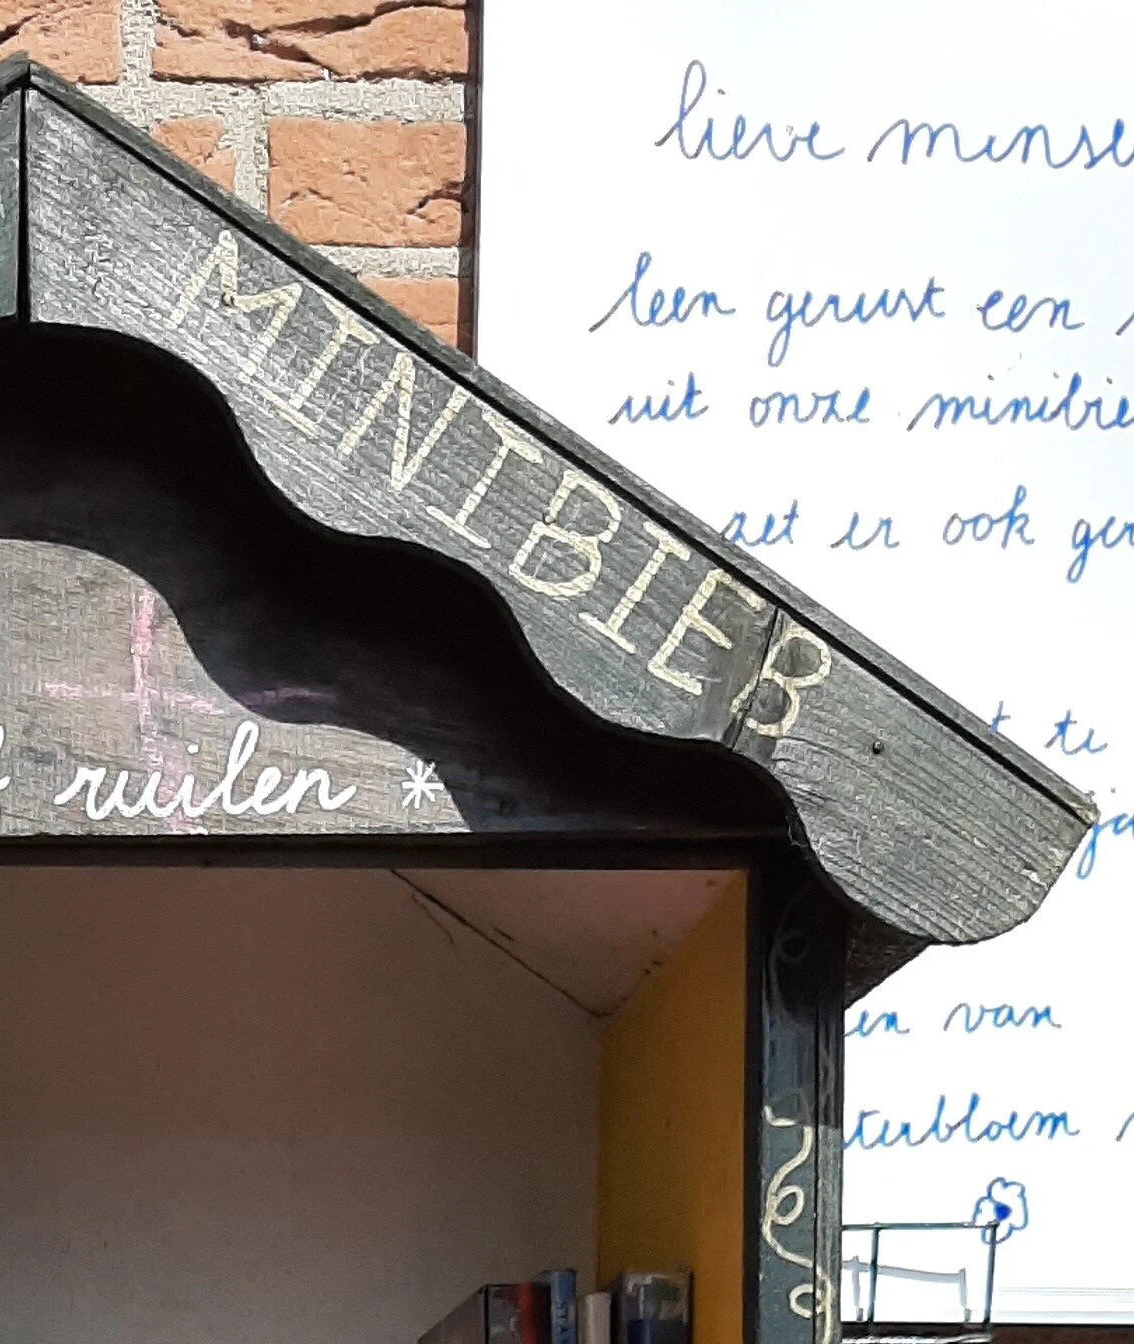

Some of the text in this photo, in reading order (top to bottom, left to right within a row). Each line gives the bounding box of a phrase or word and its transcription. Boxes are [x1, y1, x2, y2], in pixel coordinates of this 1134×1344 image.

[654, 59, 845, 161] lieve
[589, 251, 1085, 367] leen gerust een
[608, 372, 709, 424] uit
[750, 387, 870, 428] onze
[163, 230, 831, 741] MINIBIEB
[830, 512, 900, 550] er
[943, 484, 1035, 548] ook
[55, 721, 358, 820] ruilen
[943, 1002, 1061, 1033] van
[842, 1092, 1080, 1150] terbloem
